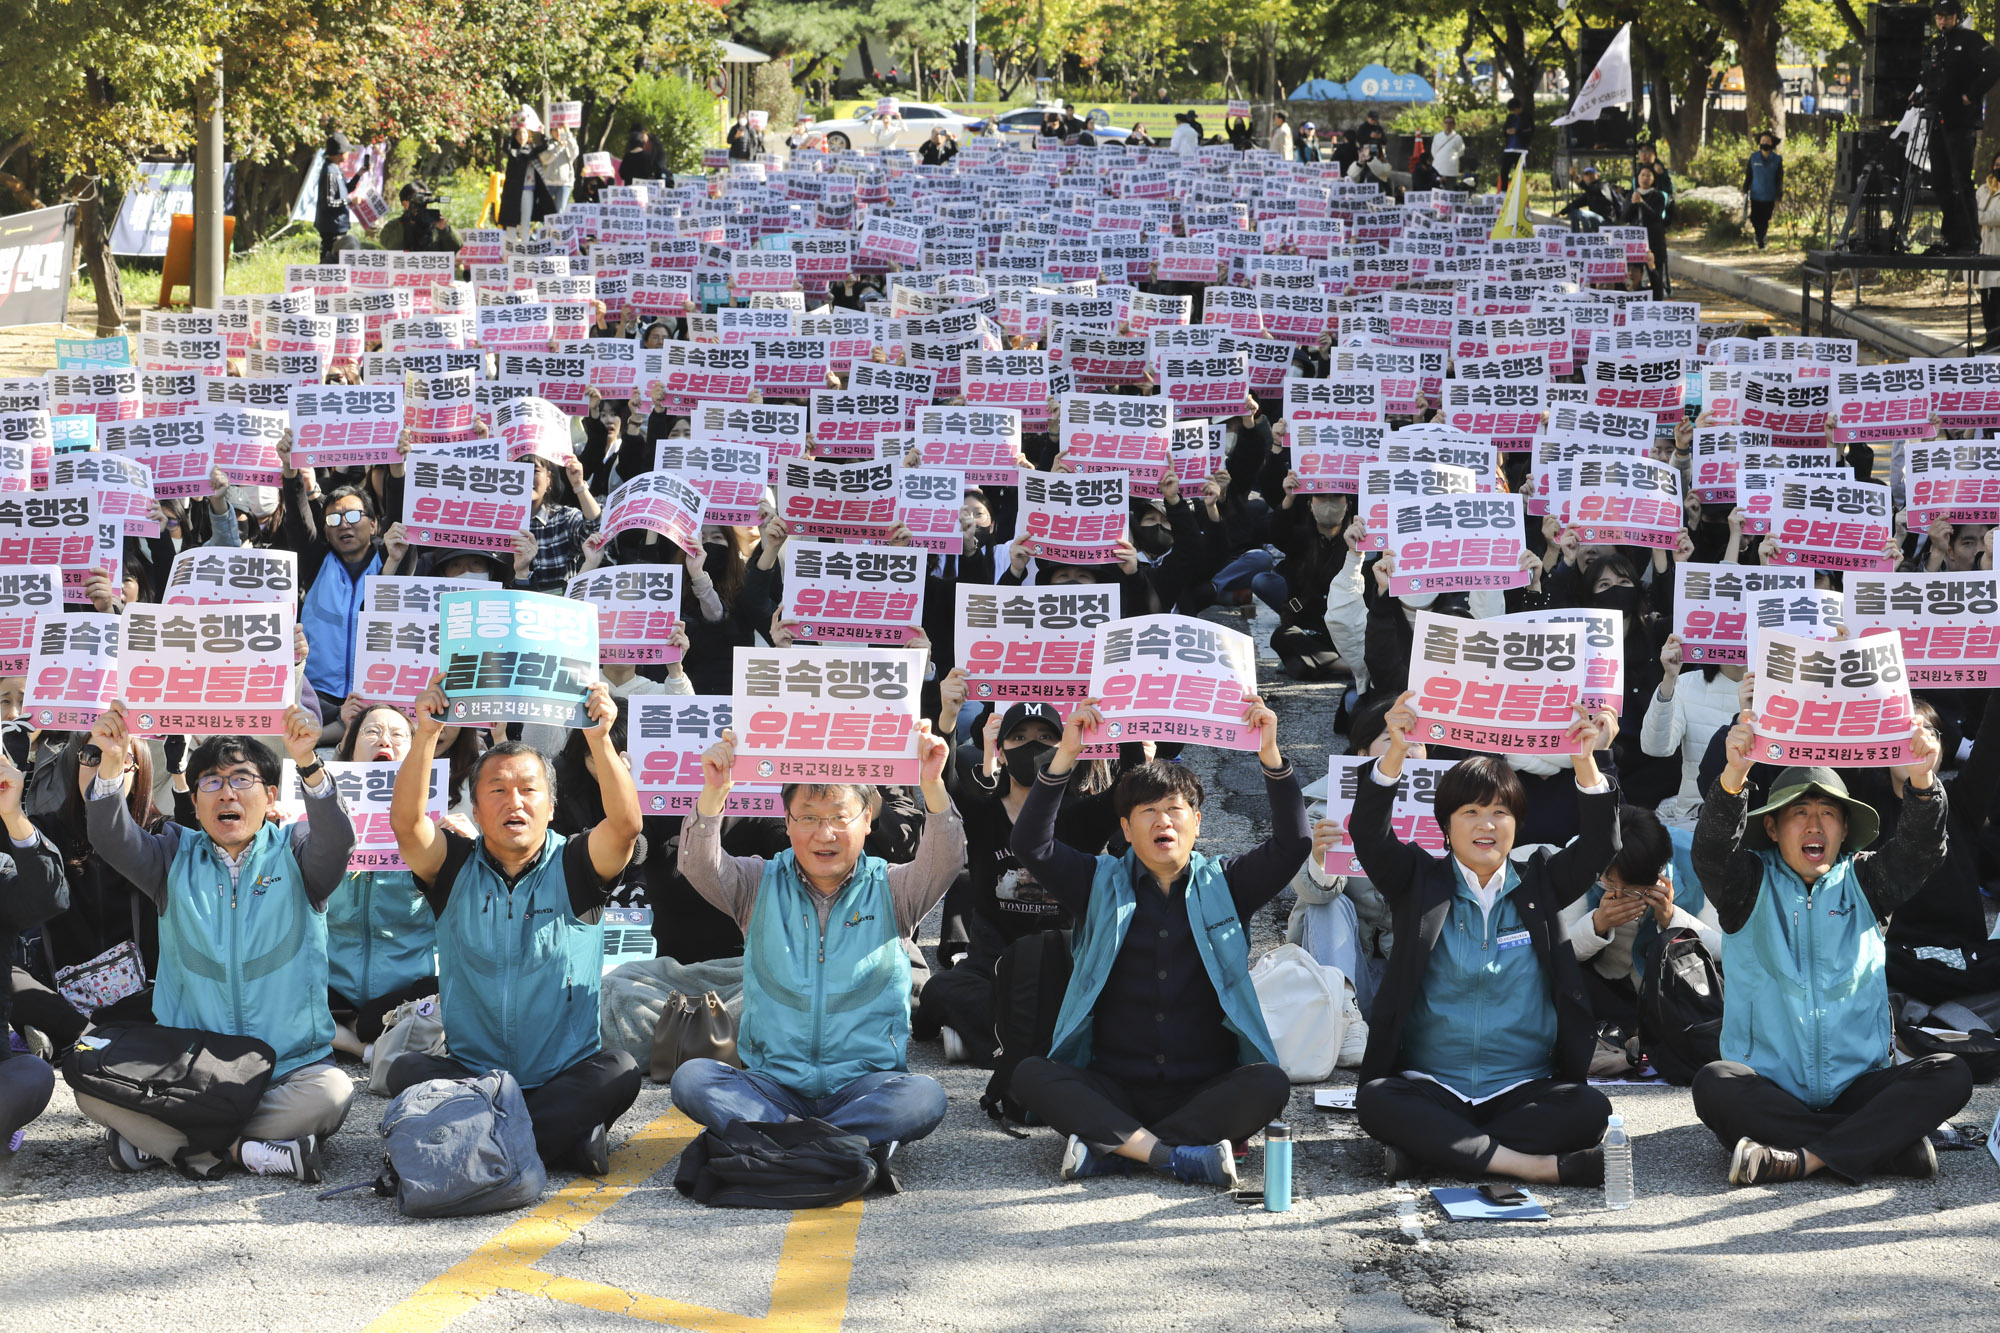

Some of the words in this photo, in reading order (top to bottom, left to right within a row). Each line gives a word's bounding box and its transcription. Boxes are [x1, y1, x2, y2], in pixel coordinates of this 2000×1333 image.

[791, 240, 847, 254] 졸속행정
[392, 255, 450, 270] 졸속행정
[1353, 258, 1409, 273] 졸속행정
[1433, 258, 1482, 273] 졸속행정
[1511, 264, 1567, 282] 졸속행정
[631, 272, 688, 289] 졸속행정
[1260, 272, 1315, 290] 졸속행정
[631, 290, 689, 306] 유보통합
[1050, 300, 1113, 319] 졸속행정
[1132, 295, 1188, 315] 졸속행정
[1260, 293, 1324, 313] 졸속행정
[1388, 296, 1453, 317] 졸속행정
[481, 306, 548, 324] 졸속행정
[722, 311, 788, 328] 졸속행정
[906, 314, 977, 337] 졸속행정
[1262, 313, 1325, 334] 유보통합
[1631, 305, 1695, 323] 졸속행정
[482, 325, 551, 342] 유보통합
[801, 317, 869, 336] 졸속행정
[1390, 316, 1453, 337] 유보통합
[1491, 316, 1566, 338] 졸속행정
[751, 340, 825, 360] 졸속행정
[1069, 338, 1145, 358] 졸속행정
[1615, 329, 1692, 350] 졸속행정
[668, 345, 750, 370] 졸속행정
[1336, 352, 1415, 374] 졸속행정
[1781, 342, 1852, 363] 졸속행정
[250, 355, 318, 374] 졸속행정
[505, 356, 585, 378] 졸속행정
[754, 364, 827, 383] 유보통합
[965, 355, 1044, 376] 졸속행정
[1070, 357, 1146, 376] 유보통합
[1166, 356, 1244, 378] 졸속행정
[1461, 356, 1544, 380] 졸속행정
[1596, 358, 1681, 384] 졸속행정
[54, 373, 136, 396] 졸속행정
[666, 371, 752, 395] 유보통합
[855, 366, 932, 394] 졸속행정
[1167, 381, 1247, 402] 유보통합
[1838, 368, 1925, 395] 졸속행정
[207, 381, 292, 404] 졸속행정
[966, 381, 1048, 403] 유보통합
[1290, 383, 1375, 405] 졸속행정
[1449, 384, 1539, 407] 졸속행정
[1595, 385, 1683, 409] 유보통합
[1744, 380, 1829, 409] 졸속행정
[296, 391, 396, 417] 졸속행정
[816, 394, 899, 415] 졸속행정
[1068, 400, 1168, 429] 졸속행정
[1840, 397, 1929, 424] 유보통합
[404, 403, 473, 430] 유보통합
[704, 407, 800, 436] 졸속행정
[922, 411, 1015, 437] 졸속행정
[1451, 412, 1541, 434] 유보통합
[1556, 407, 1650, 441] 졸속행정
[1741, 408, 1829, 434] 유보통합
[106, 420, 205, 450] 졸속행정
[299, 418, 399, 447] 유보통합
[1297, 424, 1385, 450] 졸속행정
[1859, 427, 1924, 438] 전국교직원노동조합
[318, 451, 388, 463] 전국교직원노동조합
[921, 441, 1018, 467] 유보통합
[1068, 432, 1169, 461] 유보통합
[662, 446, 761, 475] 졸속행정
[55, 458, 149, 488] 졸속행정
[414, 461, 525, 496] 졸속행정
[786, 462, 893, 493] 졸속행정
[1579, 461, 1678, 496] 졸속행정
[610, 475, 701, 514] 졸속행정
[1025, 476, 1123, 507] 졸속행정
[1782, 482, 1887, 517] 졸속행정
[412, 497, 526, 530] 유보통합
[605, 497, 697, 537] 유보통합
[786, 495, 897, 523] 유보통합
[1396, 499, 1516, 534] 졸속행정
[1577, 495, 1682, 528] 유보통합
[808, 526, 886, 537] 전국교직원노동조합
[1025, 510, 1126, 541] 유보통합
[1779, 517, 1890, 552] 유보통합
[434, 532, 512, 548] 전국교직원노동조합
[1599, 530, 1673, 545] 전국교직원노동조합
[1398, 537, 1521, 571] 유보통합
[1801, 552, 1878, 568] 전국교직원노동조합
[171, 555, 292, 591] 졸속행정
[795, 549, 917, 583] 졸속행정
[569, 570, 674, 602] 졸속행정
[1425, 575, 1510, 589] 전국교직원노동조합
[793, 587, 919, 621] 유보통합
[1853, 580, 1999, 616] 졸속행정
[966, 593, 1110, 630] 졸속행정
[127, 613, 282, 652] 졸속행정
[446, 600, 590, 648] 불통행정
[817, 626, 903, 640] 전국교직원노동조합
[1103, 624, 1248, 672] 졸속행정
[1424, 624, 1577, 673] 졸속행정
[444, 652, 594, 696] 늘봄학교
[1766, 641, 1901, 689] 졸속행정
[125, 664, 288, 703] 유보통합
[745, 659, 908, 700] 졸속행정
[1101, 674, 1253, 717] 유보통합
[1418, 676, 1579, 723] 유보통합
[471, 701, 577, 721] 전국교직원노동조합
[1024, 702, 1043, 717] M
[1758, 692, 1912, 737] 유보통합
[159, 714, 272, 729] 전국교직원노동조합
[745, 711, 914, 752] 유보통합
[1127, 721, 1237, 742] 전국교직원노동조합
[1451, 727, 1561, 749] 전국교직원노동조합
[1788, 745, 1902, 761] 전국교직원노동조합
[780, 762, 895, 779] 전국교직원노동조합
